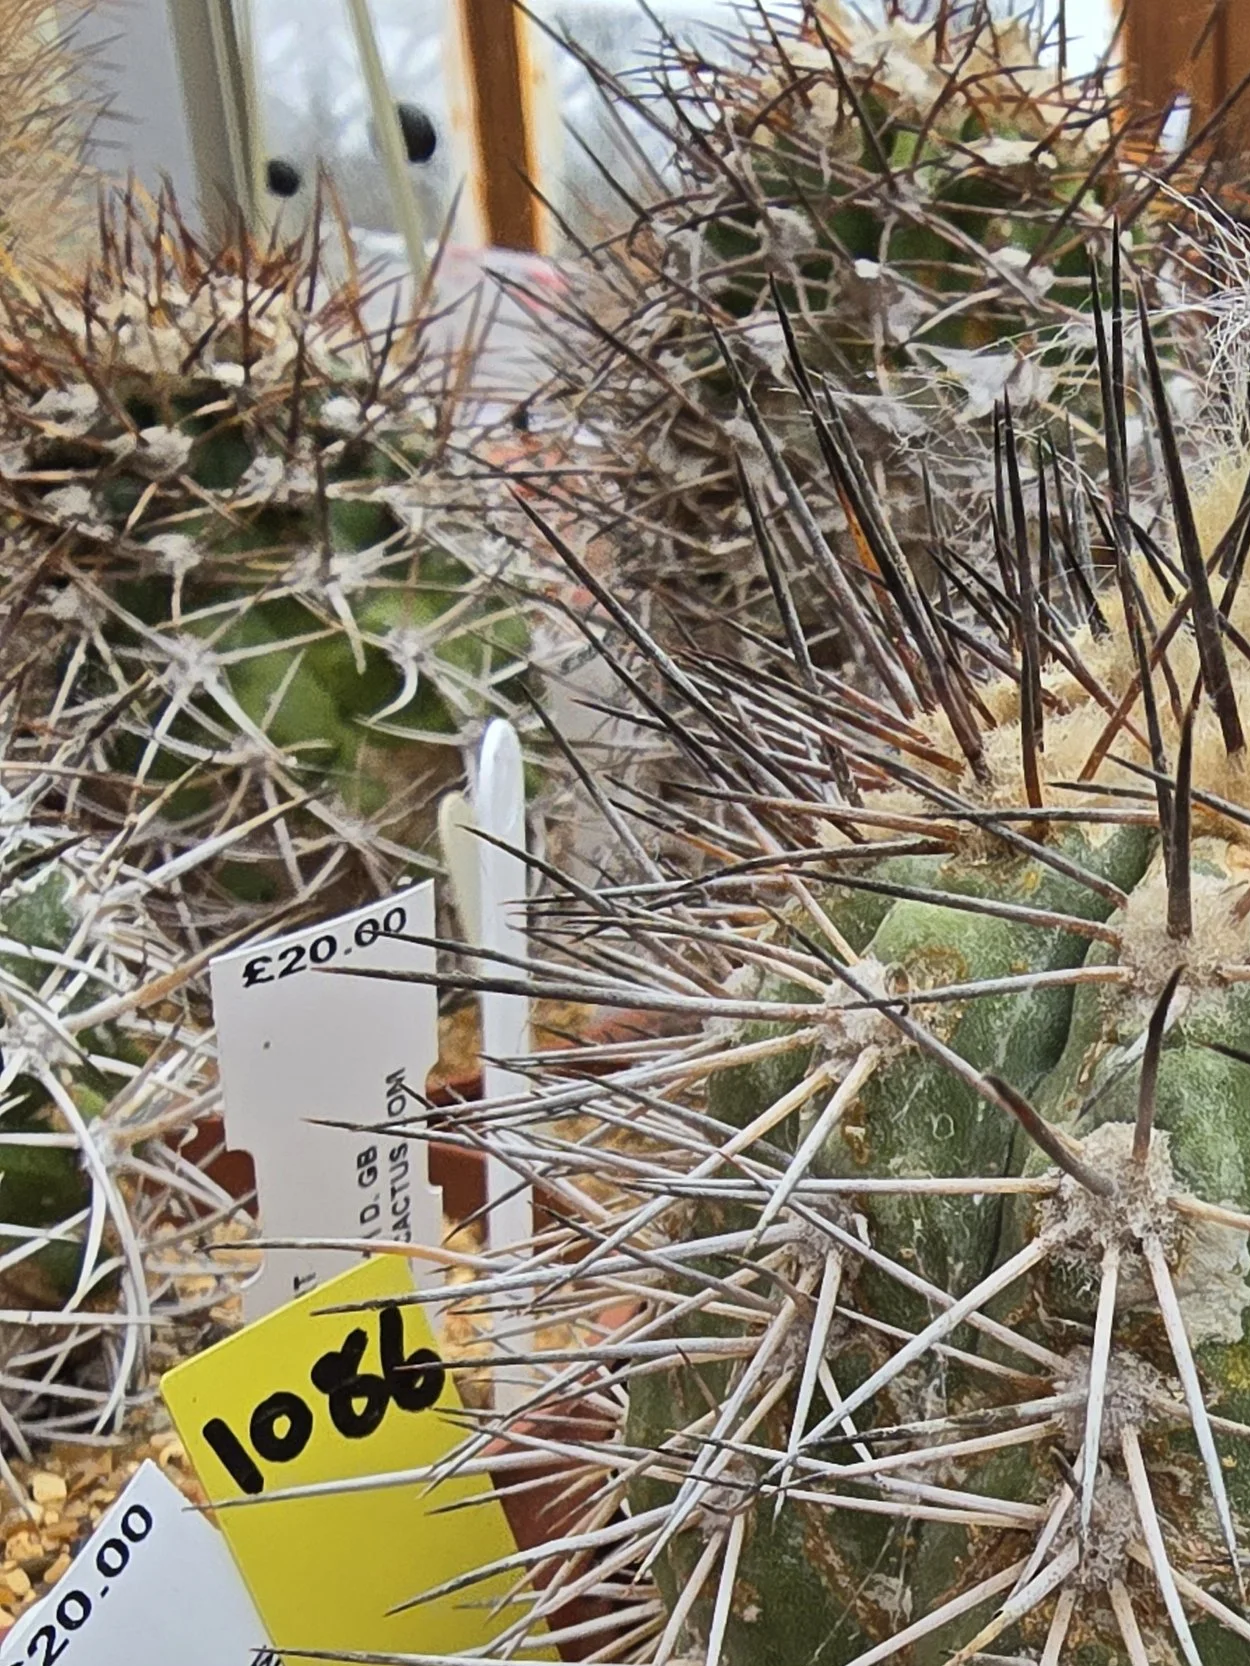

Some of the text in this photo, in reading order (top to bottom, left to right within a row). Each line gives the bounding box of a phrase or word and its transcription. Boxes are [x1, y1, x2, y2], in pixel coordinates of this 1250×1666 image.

[242, 907, 407, 988] £20.00
[357, 1145, 378, 1188] GB
[202, 1299, 446, 1495] 1086
